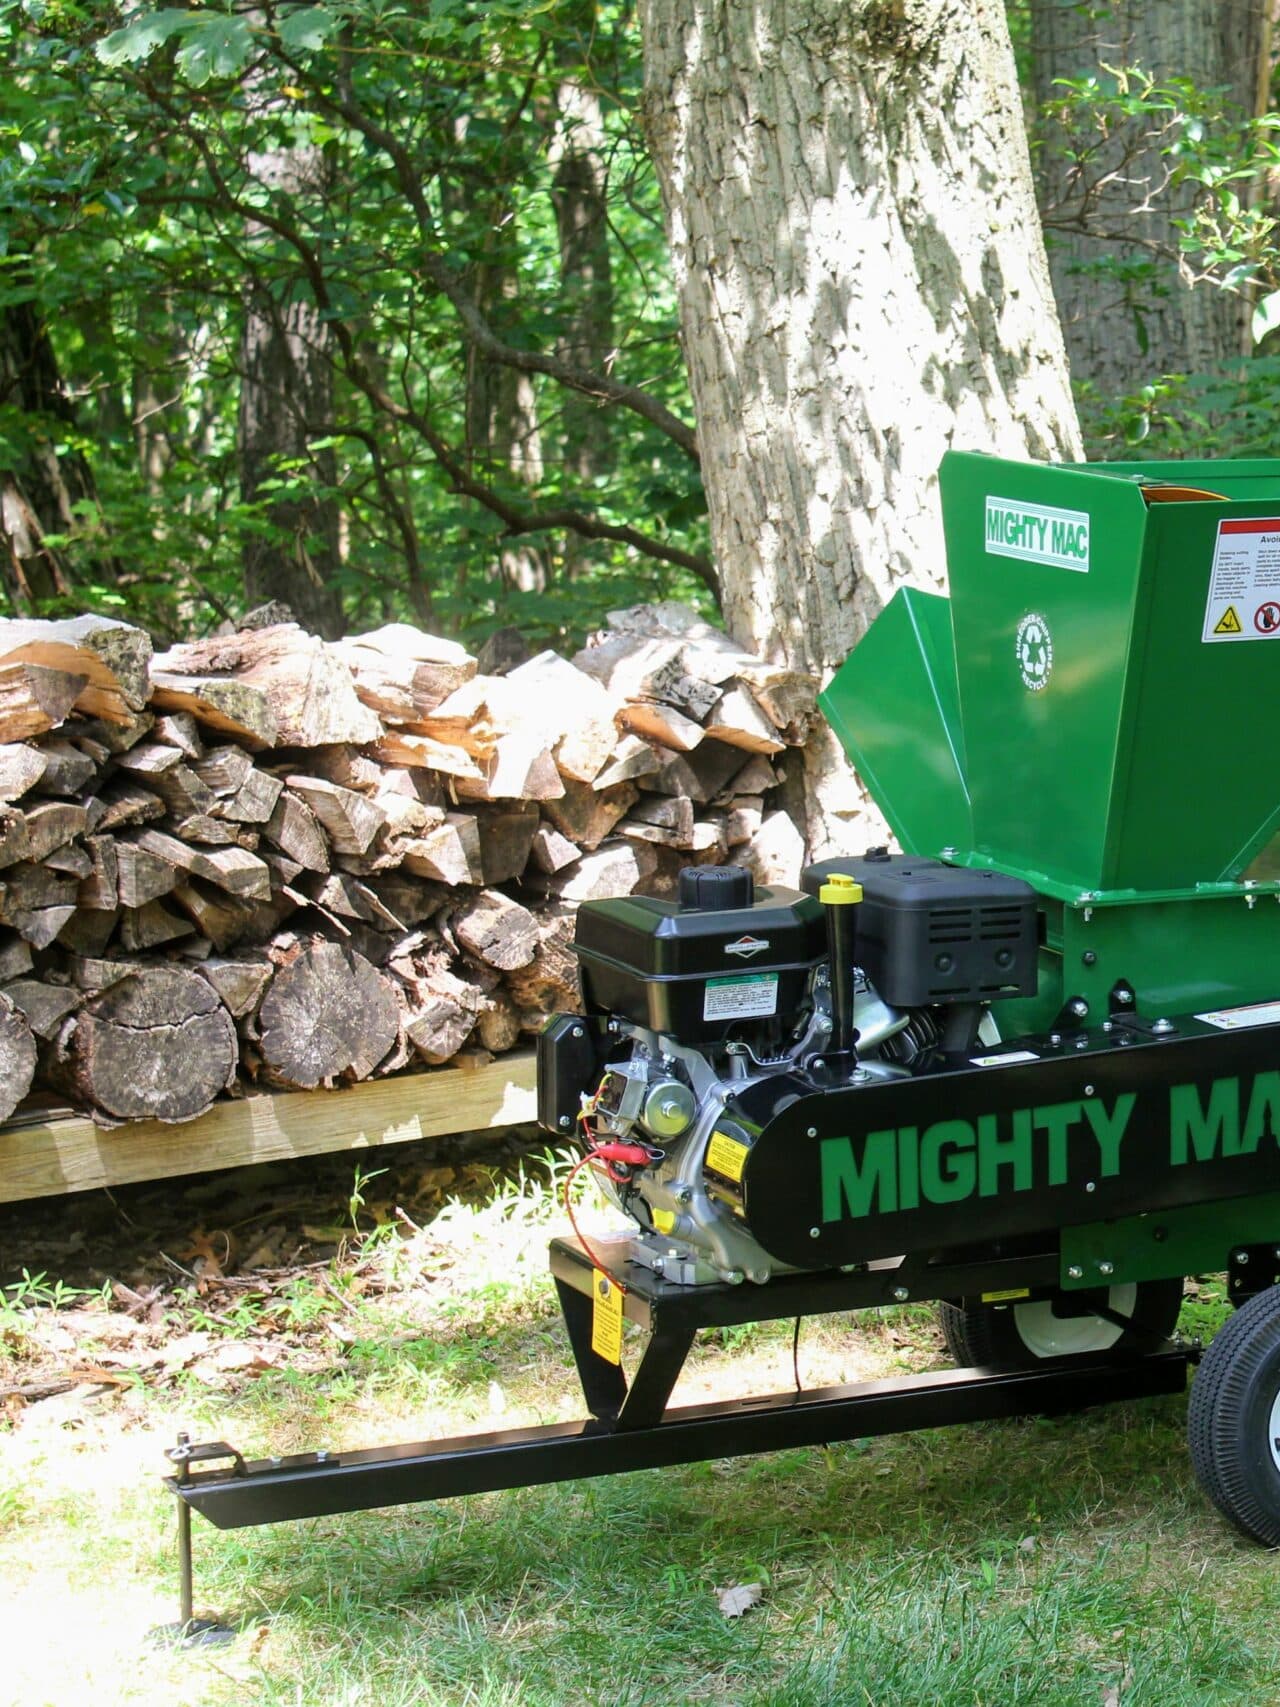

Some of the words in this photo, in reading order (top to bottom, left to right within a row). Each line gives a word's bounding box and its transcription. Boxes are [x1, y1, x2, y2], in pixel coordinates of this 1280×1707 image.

[987, 508, 1048, 551] MIGHTY
[1051, 520, 1088, 559] MAC
[820, 1092, 1137, 1223] MIGHTY
